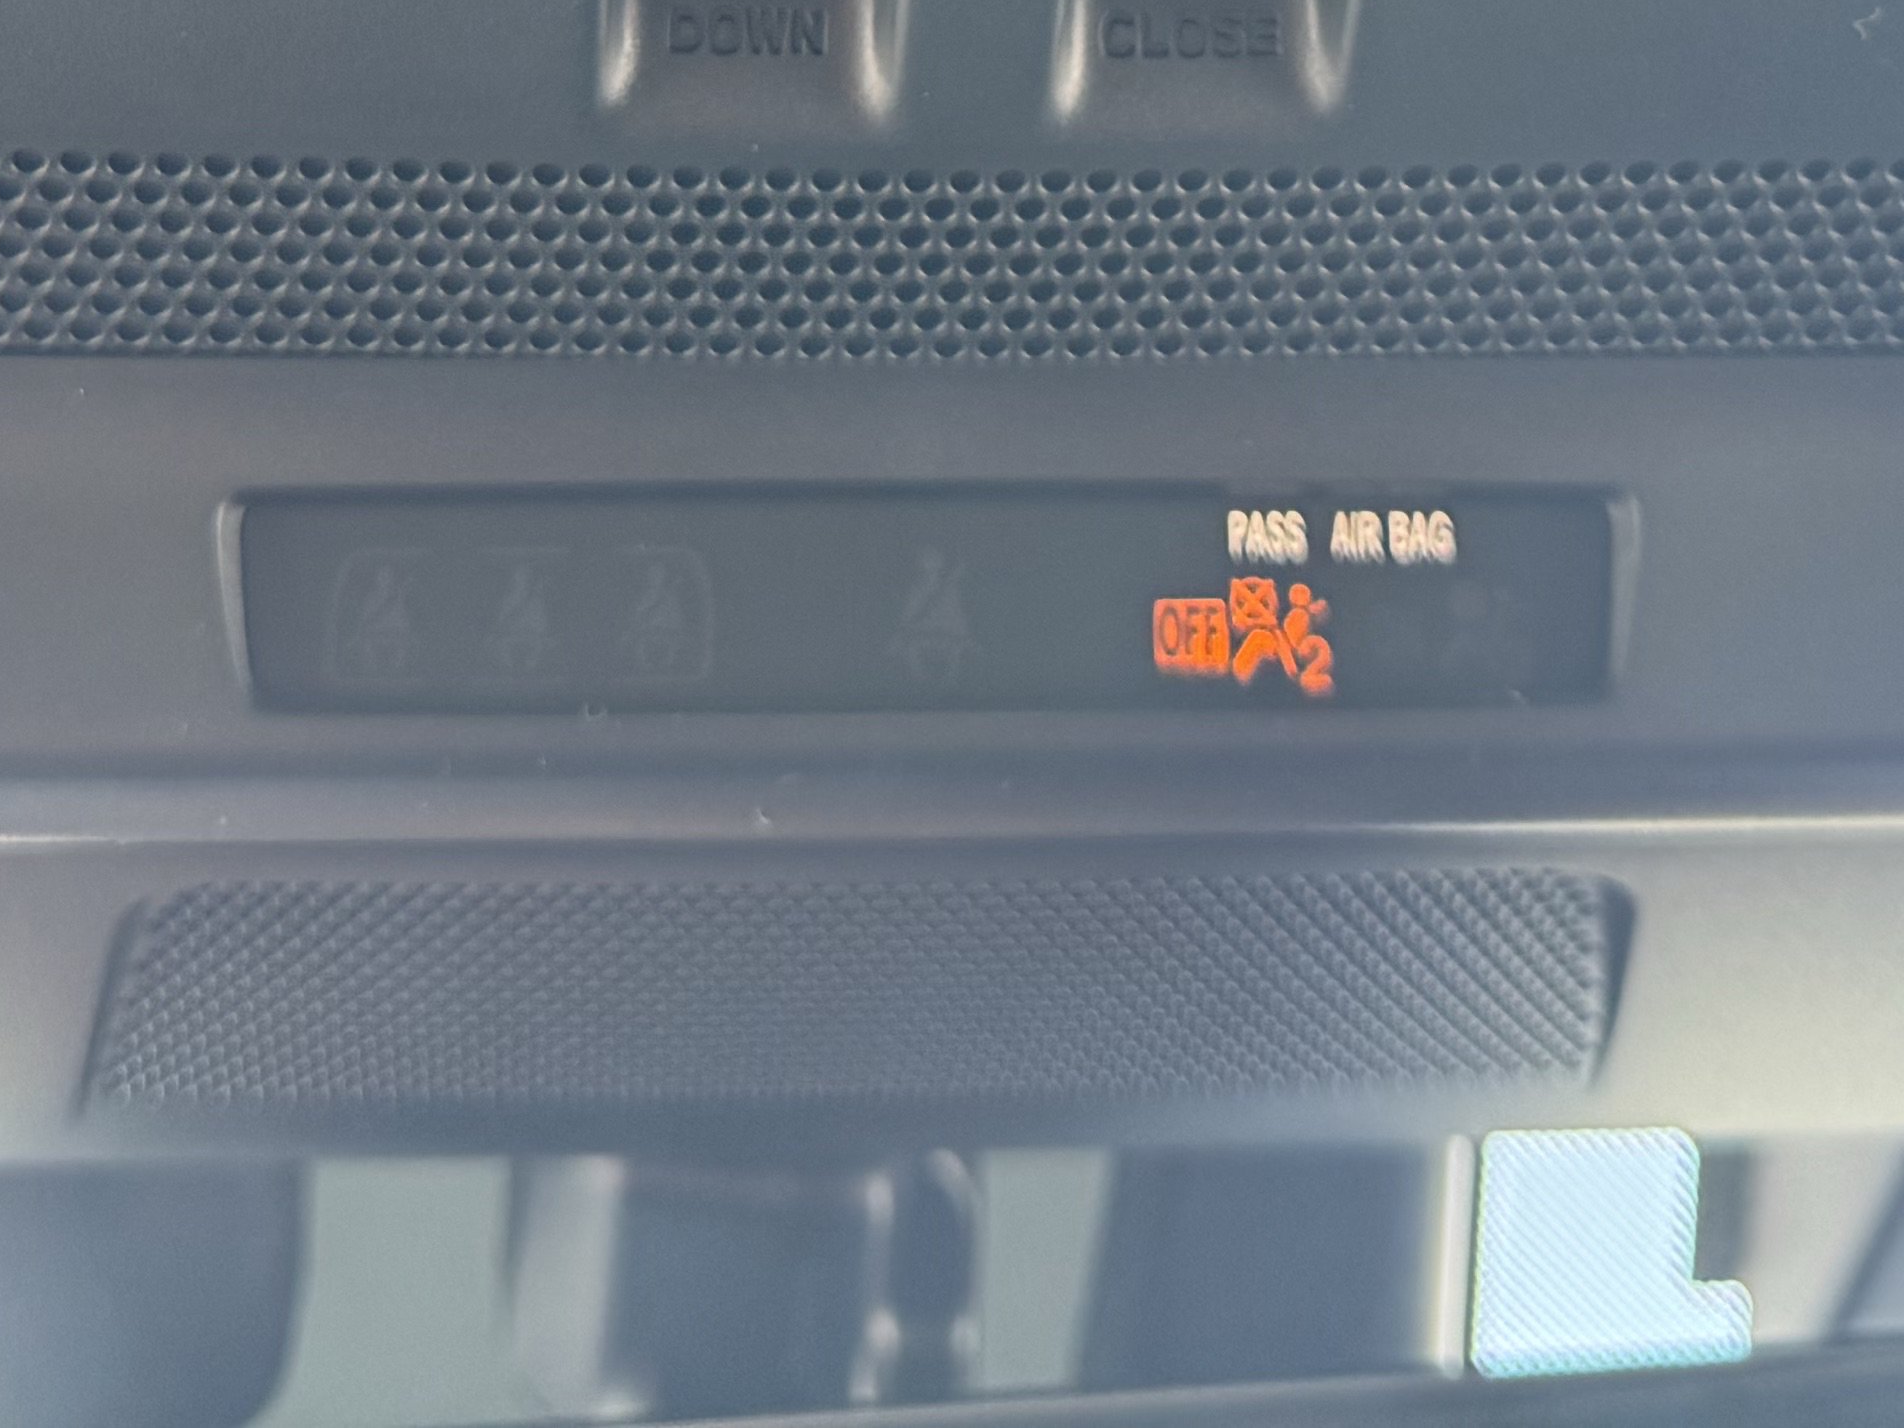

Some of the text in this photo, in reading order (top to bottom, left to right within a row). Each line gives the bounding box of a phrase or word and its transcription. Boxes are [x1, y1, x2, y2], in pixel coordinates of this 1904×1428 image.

[667, 10, 827, 56] DOWN
[1099, 14, 1284, 59] CLOSE
[1227, 510, 1457, 565] PASS AIR BAG
[1159, 606, 1218, 656] OFF
